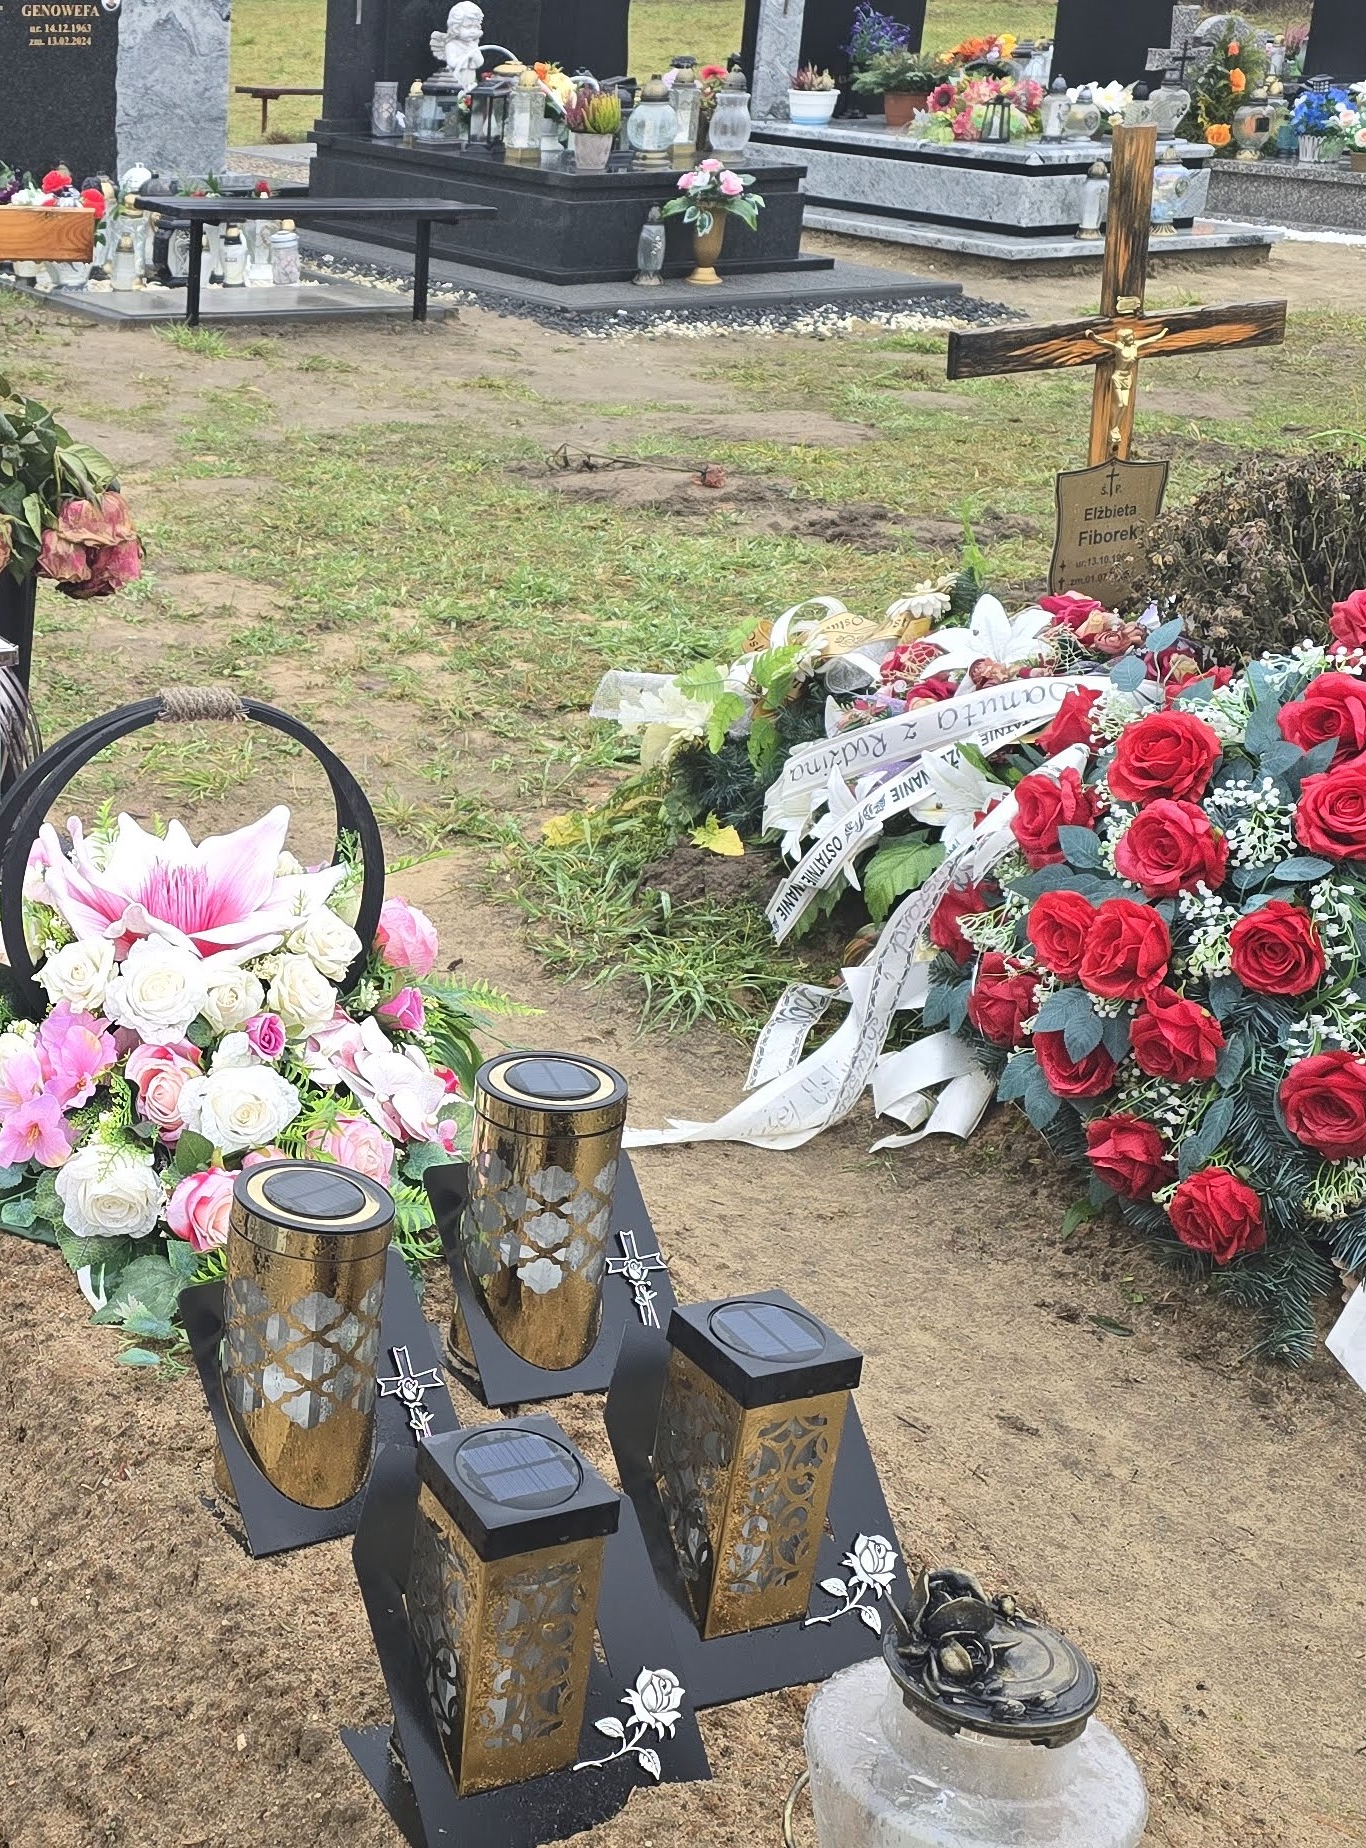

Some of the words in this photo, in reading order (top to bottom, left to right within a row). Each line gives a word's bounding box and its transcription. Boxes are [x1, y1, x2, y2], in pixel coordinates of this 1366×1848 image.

[21, 4, 101, 17] GENOWEFA
[1084, 503, 1138, 522] Elżbieta
[1078, 524, 1139, 547] Fiborek
